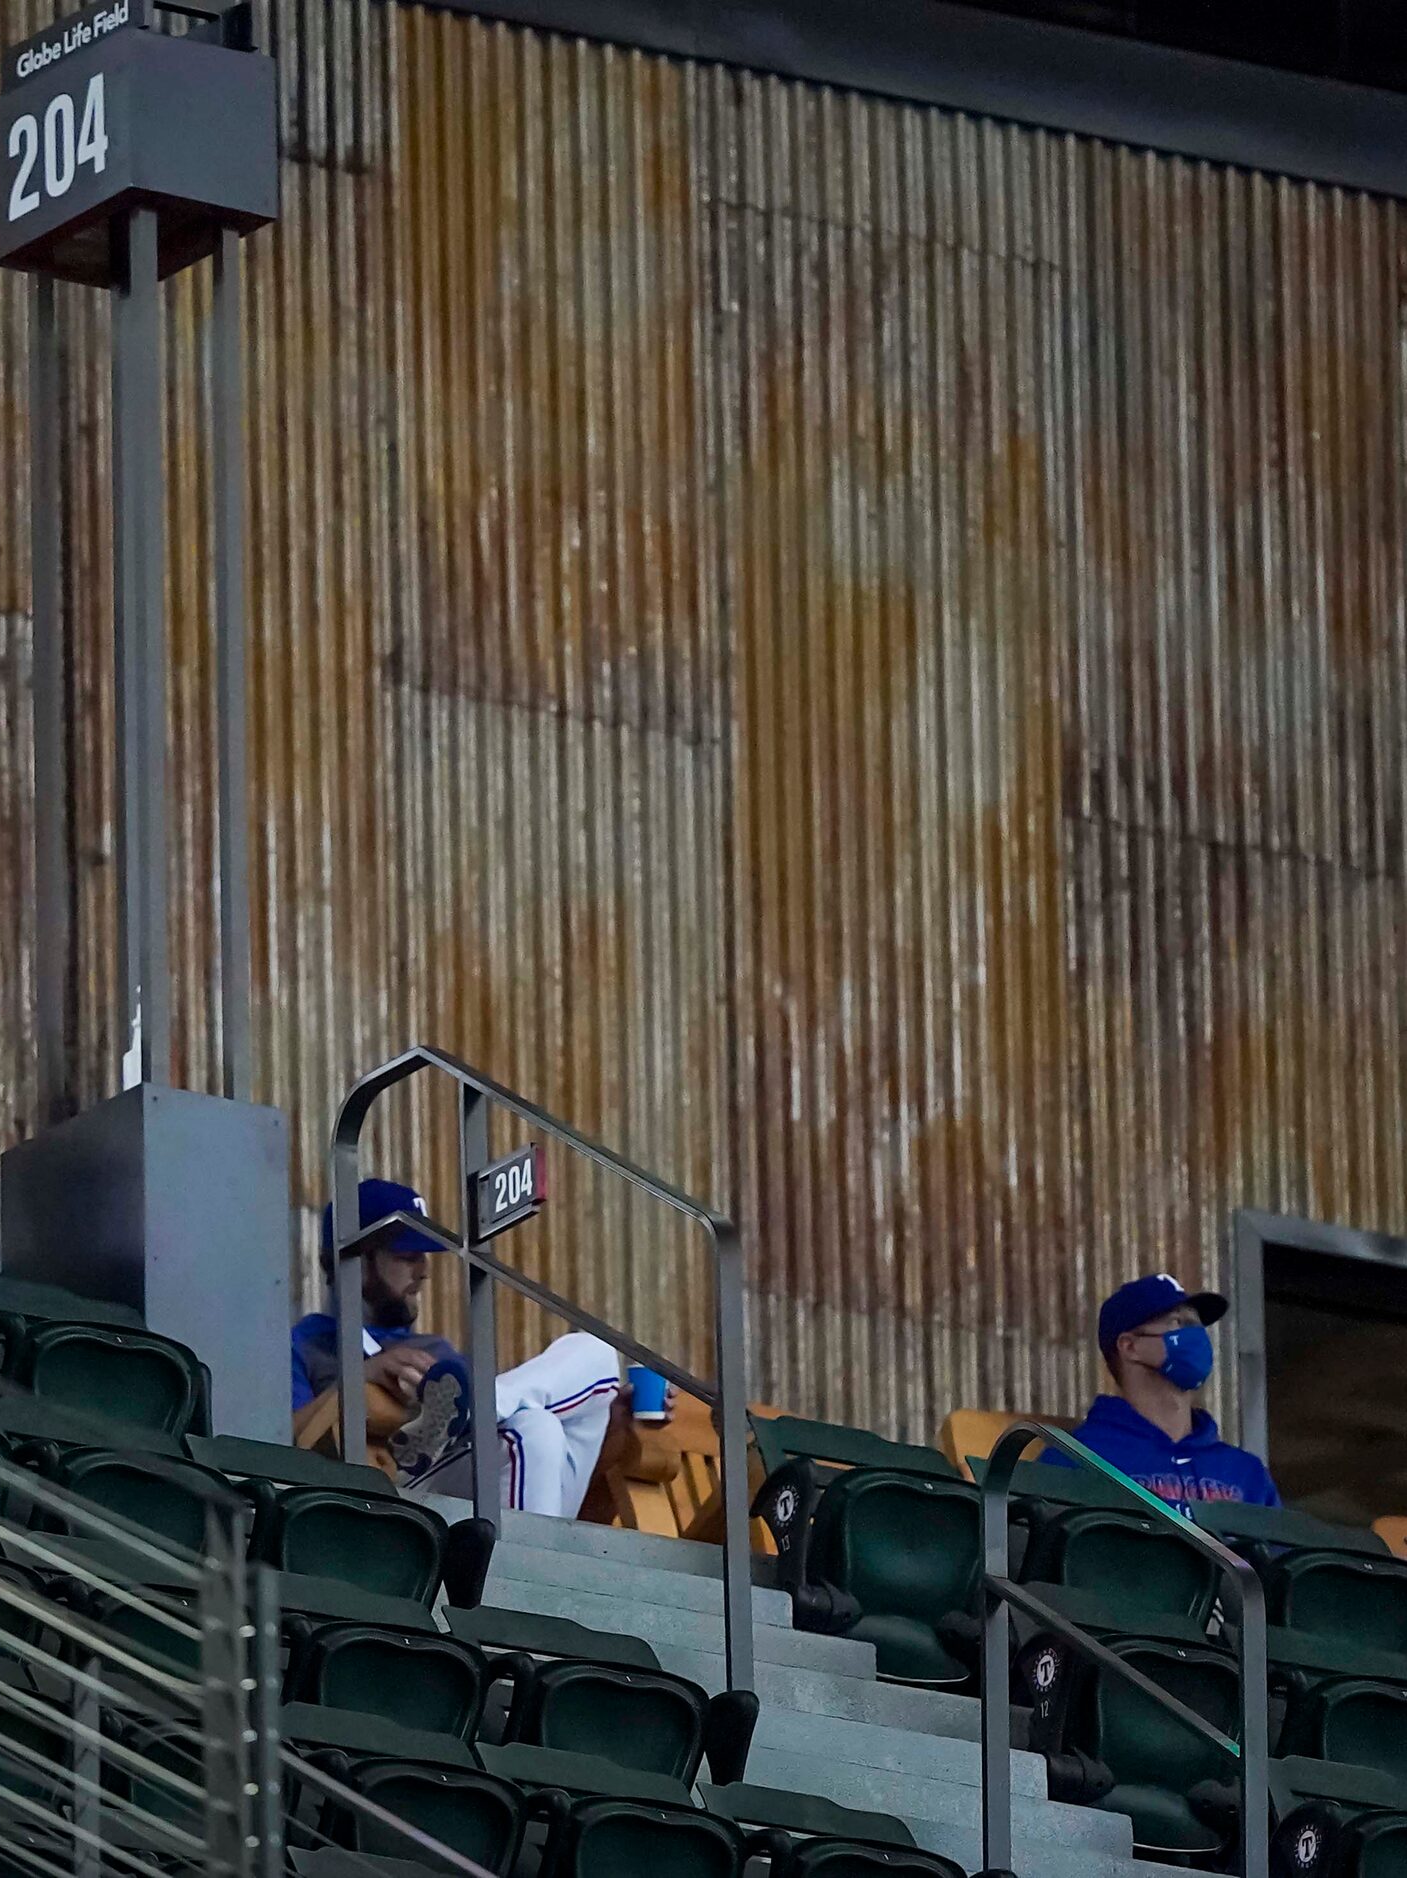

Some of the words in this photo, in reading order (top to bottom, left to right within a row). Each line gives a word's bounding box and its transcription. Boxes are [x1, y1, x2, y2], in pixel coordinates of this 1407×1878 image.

[16, 41, 62, 77] Globe
[63, 21, 92, 54] Life
[93, 0, 129, 38] Field
[8, 72, 109, 222] 204
[494, 1158, 533, 1214] 204
[1169, 1335, 1180, 1347] T
[780, 1494, 792, 1518] T
[1040, 1660, 1052, 1683] T
[1040, 1700, 1050, 1719] 12
[1302, 1836, 1313, 1859] T
